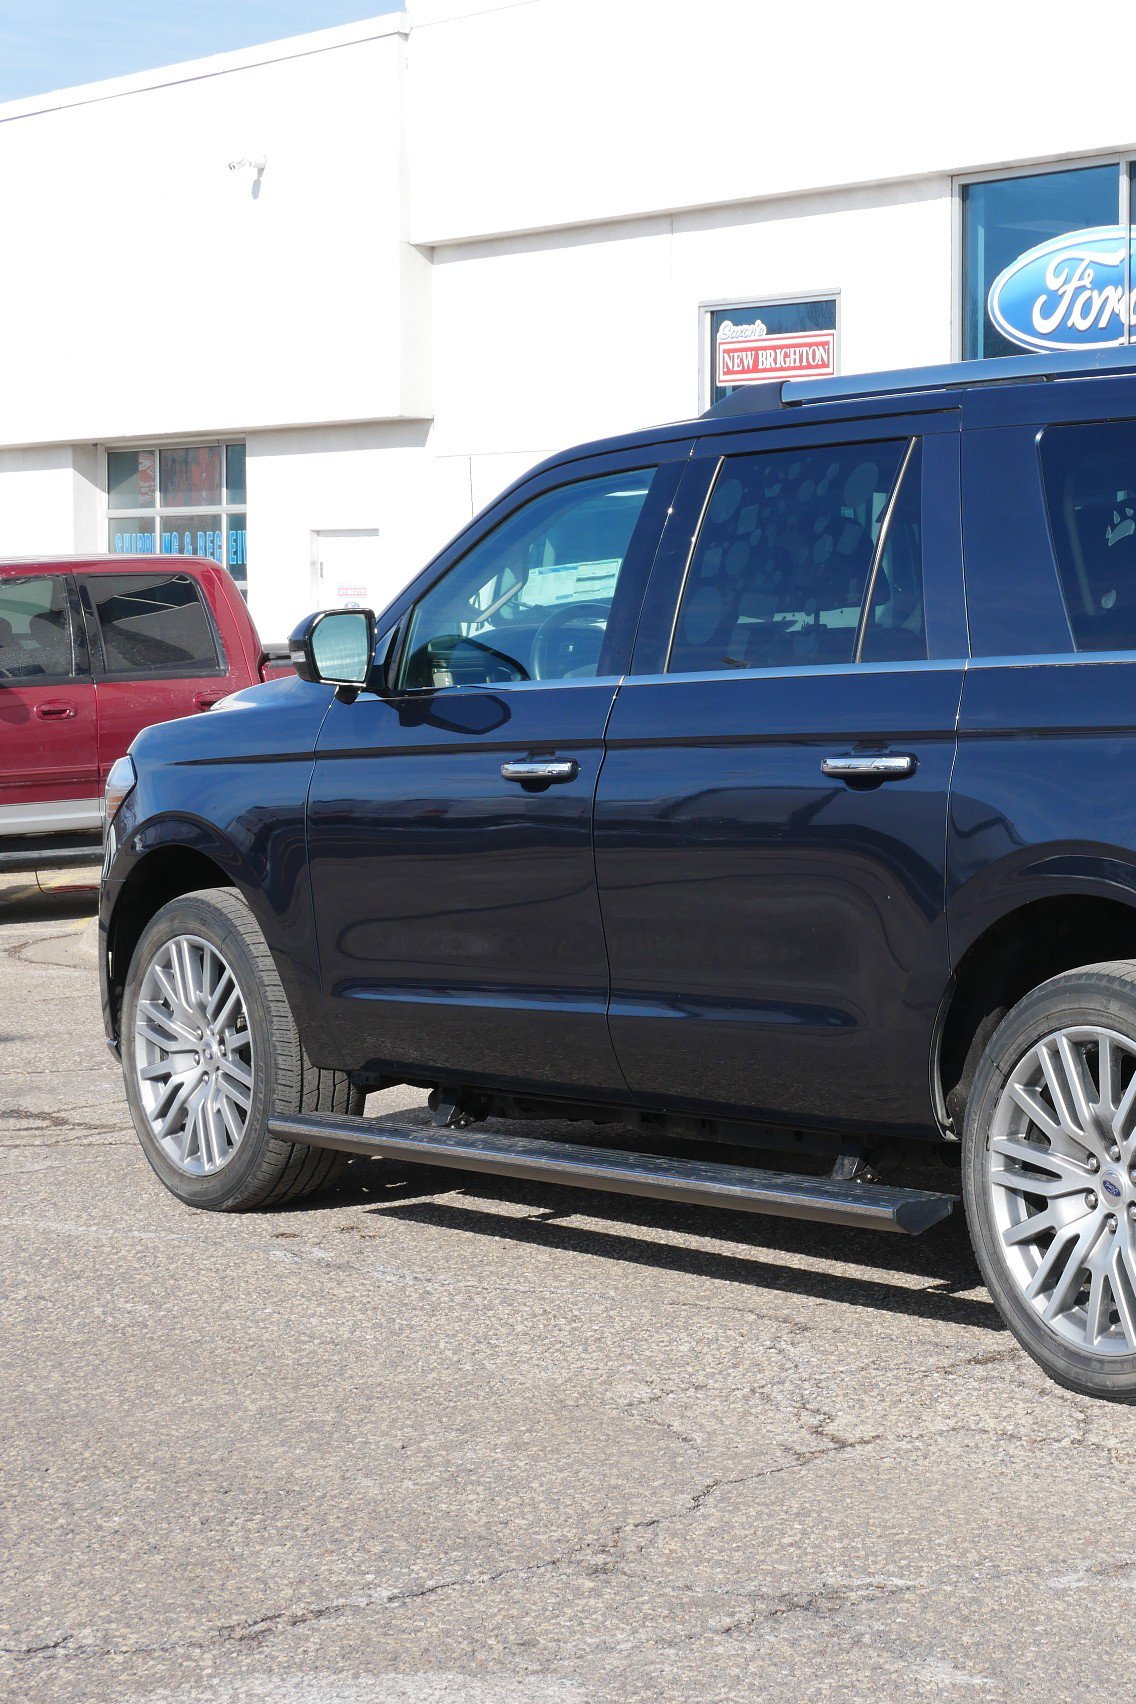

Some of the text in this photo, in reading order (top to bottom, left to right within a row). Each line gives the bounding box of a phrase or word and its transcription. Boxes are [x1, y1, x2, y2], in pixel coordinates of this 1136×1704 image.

[723, 345, 829, 372] NEW BRIGHTON
[184, 531, 193, 555] &
